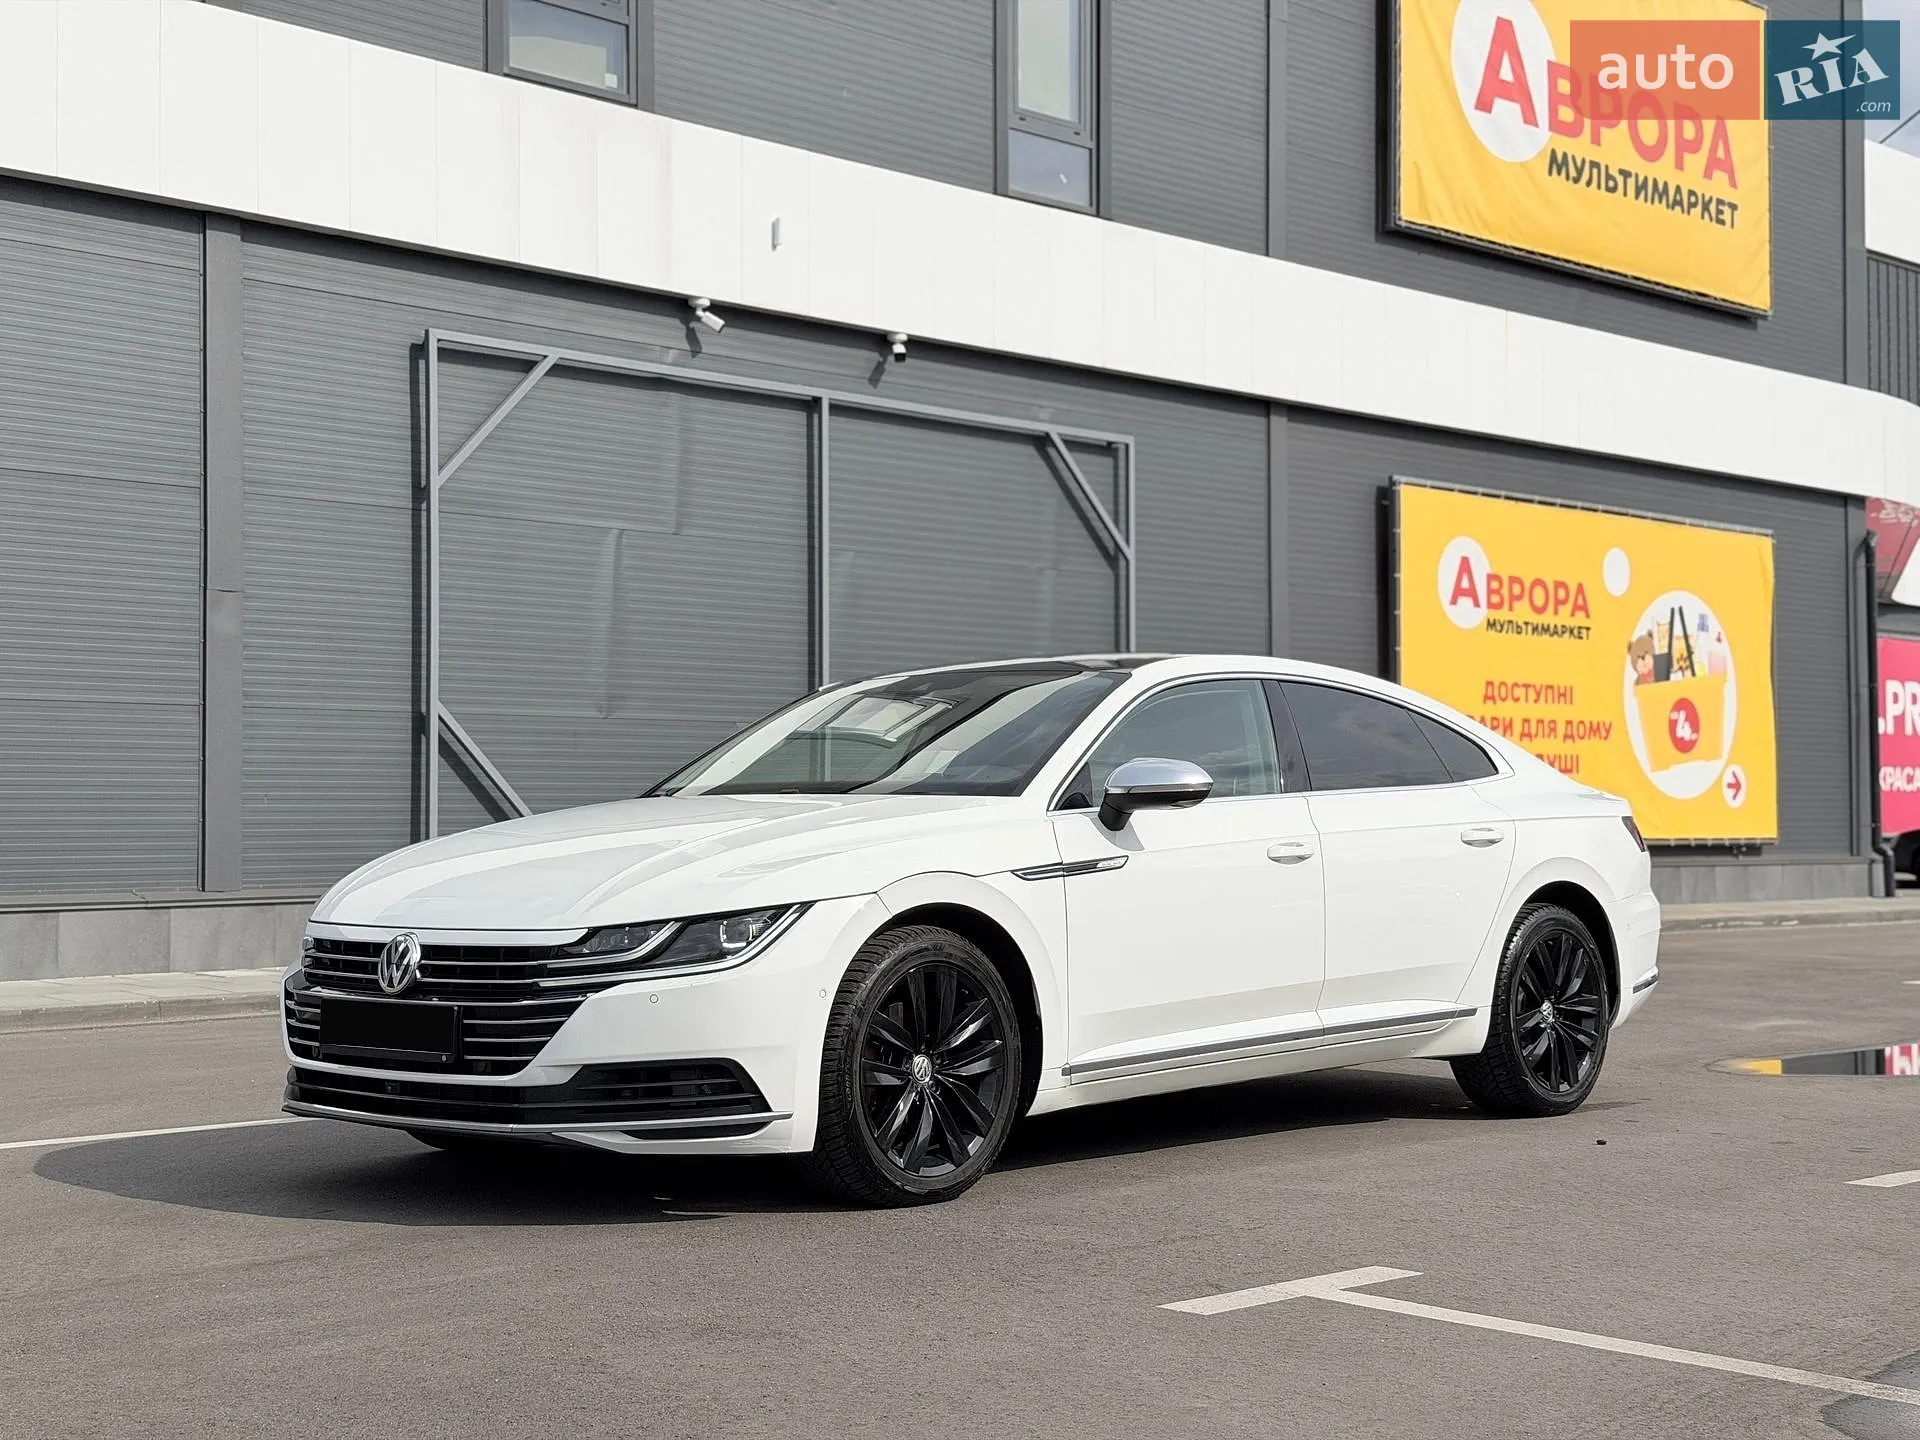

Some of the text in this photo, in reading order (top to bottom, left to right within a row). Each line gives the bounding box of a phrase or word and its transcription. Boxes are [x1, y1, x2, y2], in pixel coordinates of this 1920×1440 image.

[1547, 148, 1738, 230] МУЛЬТИМАРКЕТ
[1449, 556, 1591, 619] АВРОРА
[1486, 617, 1592, 641] МУЛЬТИМАРКЕТ
[1483, 680, 1574, 705] ДОСТУПНІ
[1519, 718, 1558, 742] ДЛЯ
[1563, 719, 1613, 743] ДОМУ
